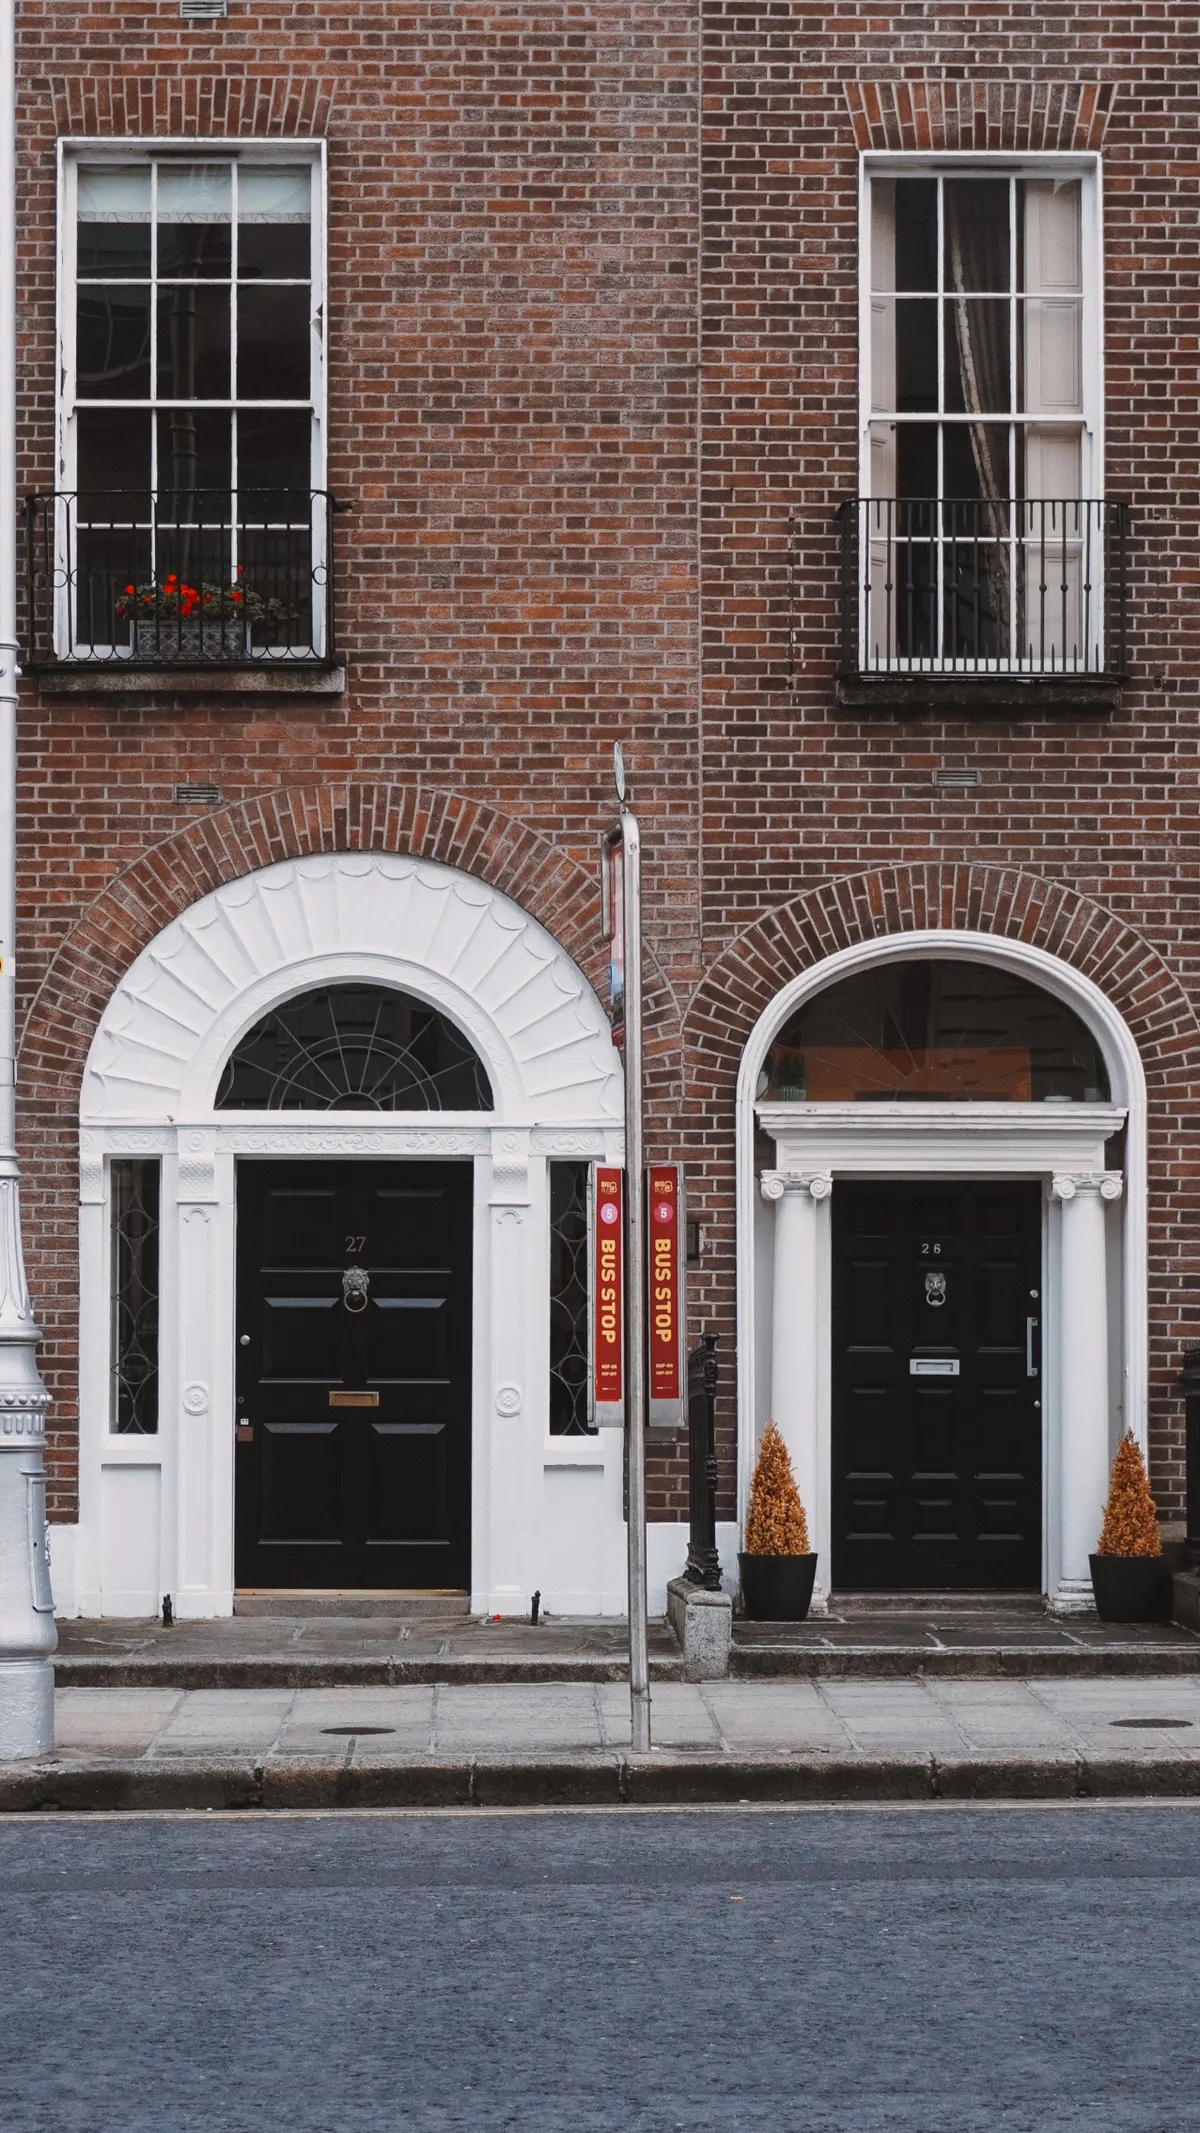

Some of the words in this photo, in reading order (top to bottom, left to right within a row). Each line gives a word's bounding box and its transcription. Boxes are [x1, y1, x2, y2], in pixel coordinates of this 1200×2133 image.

[660, 1207, 668, 1218] 5
[345, 1236, 366, 1252] 27
[601, 1239, 616, 1282] BUS
[655, 1238, 671, 1281] BUS
[921, 1243, 941, 1254] 26
[601, 1287, 616, 1344] STOP
[655, 1287, 672, 1343] STOP
